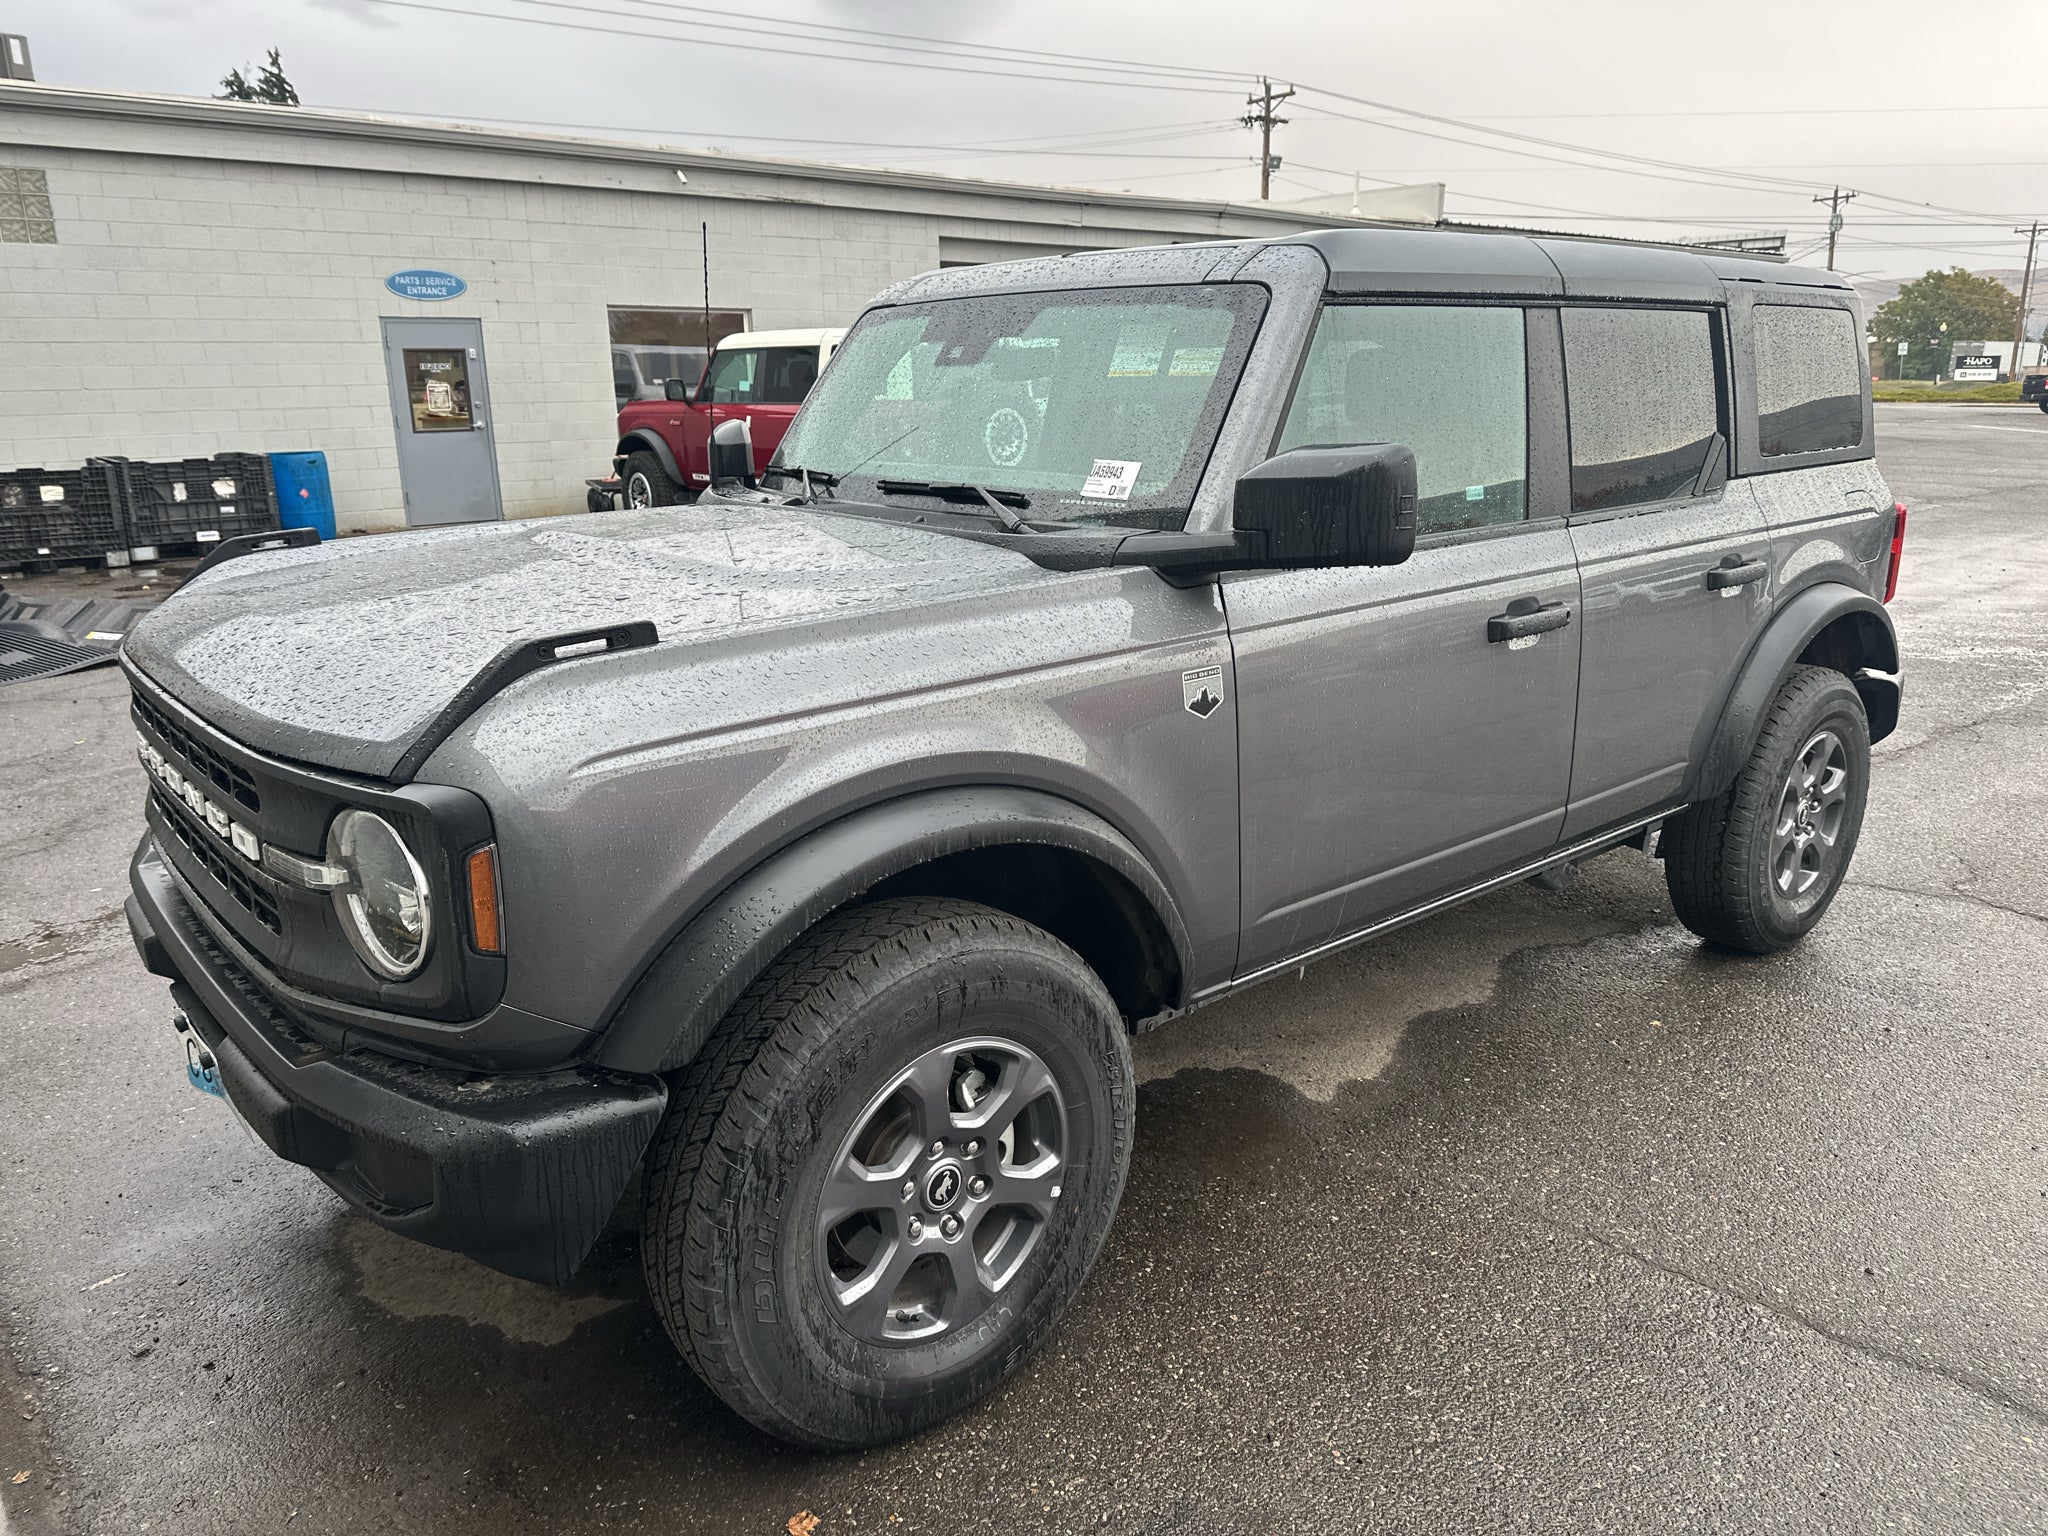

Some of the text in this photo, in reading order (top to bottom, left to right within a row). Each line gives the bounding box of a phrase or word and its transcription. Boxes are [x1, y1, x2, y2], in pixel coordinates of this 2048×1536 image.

[394, 276, 419, 285] PARTS
[425, 277, 456, 286] SERVICE
[407, 286, 447, 295] ENTRANCE
[1963, 356, 1992, 365] HAPO
[136, 730, 260, 862] BRONCO
